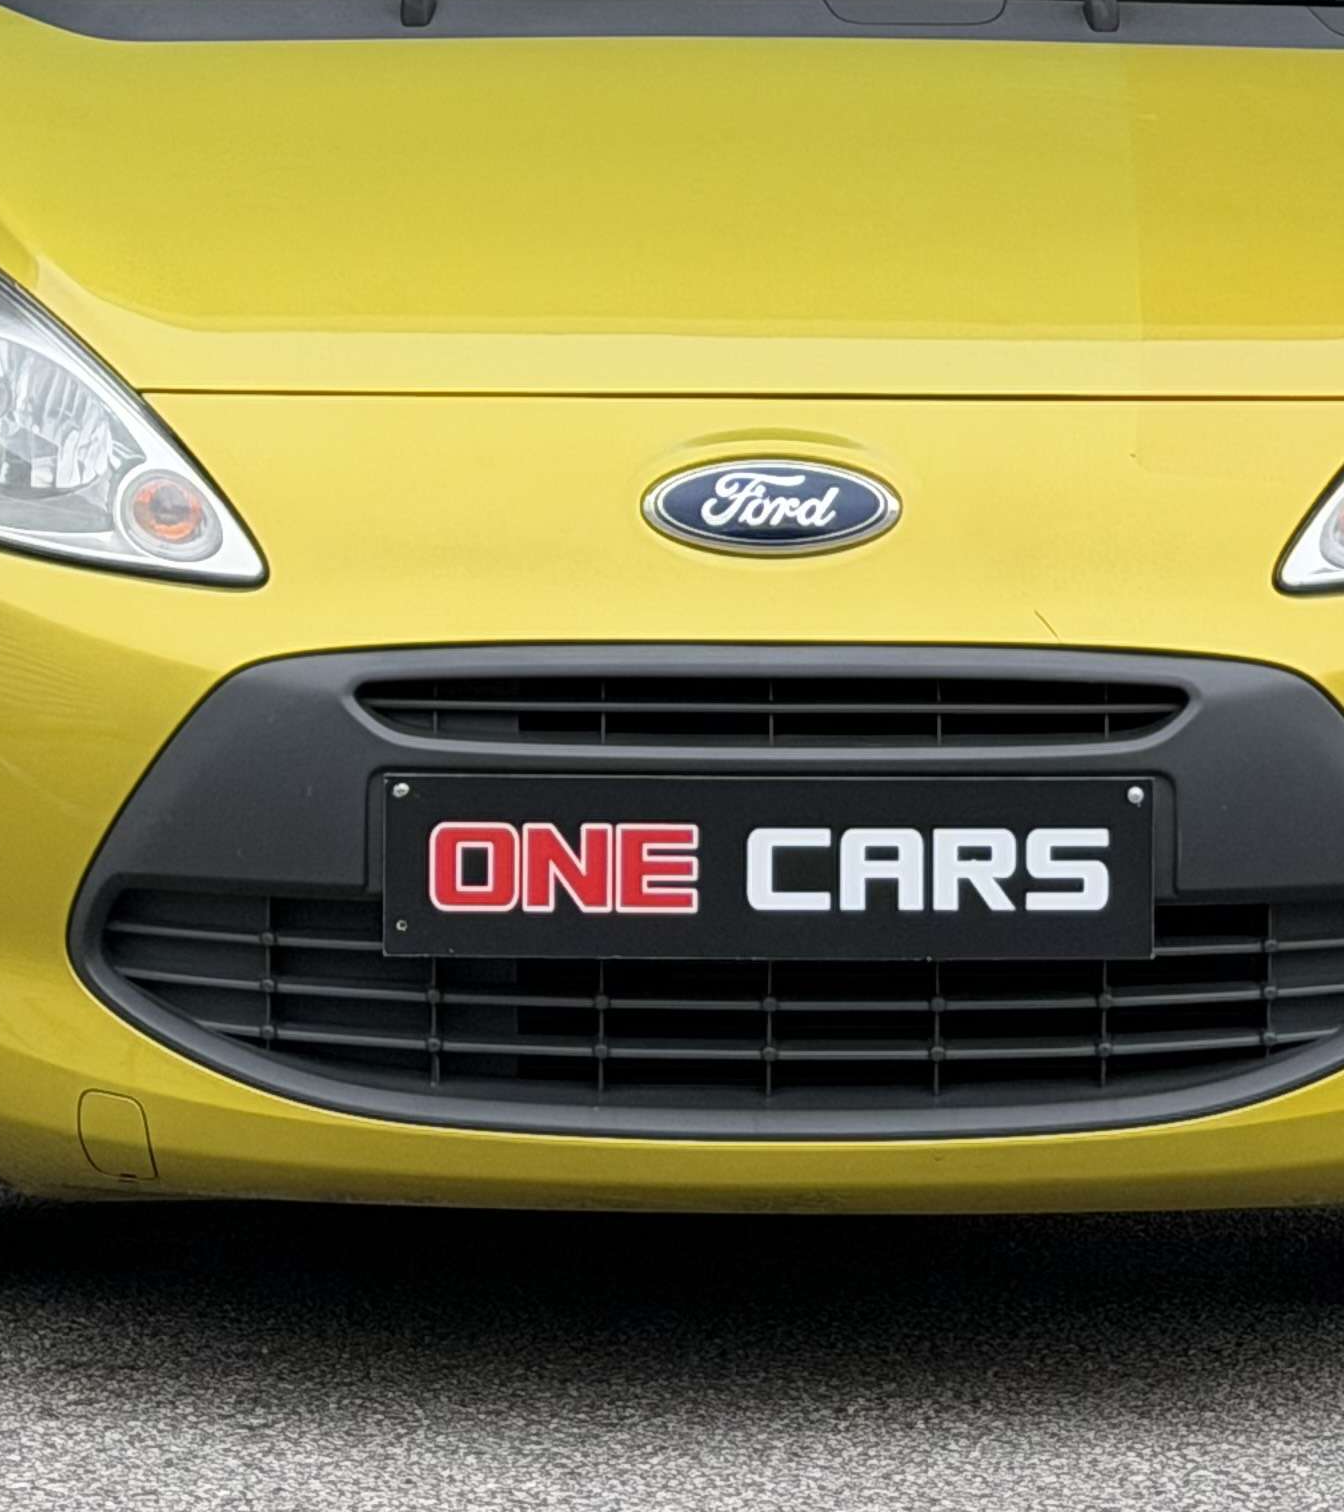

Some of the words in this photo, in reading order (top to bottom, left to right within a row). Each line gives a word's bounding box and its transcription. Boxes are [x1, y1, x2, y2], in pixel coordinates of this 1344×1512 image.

[700, 471, 840, 527] Ford
[428, 820, 699, 914] ONE
[745, 826, 1110, 912] CARS
